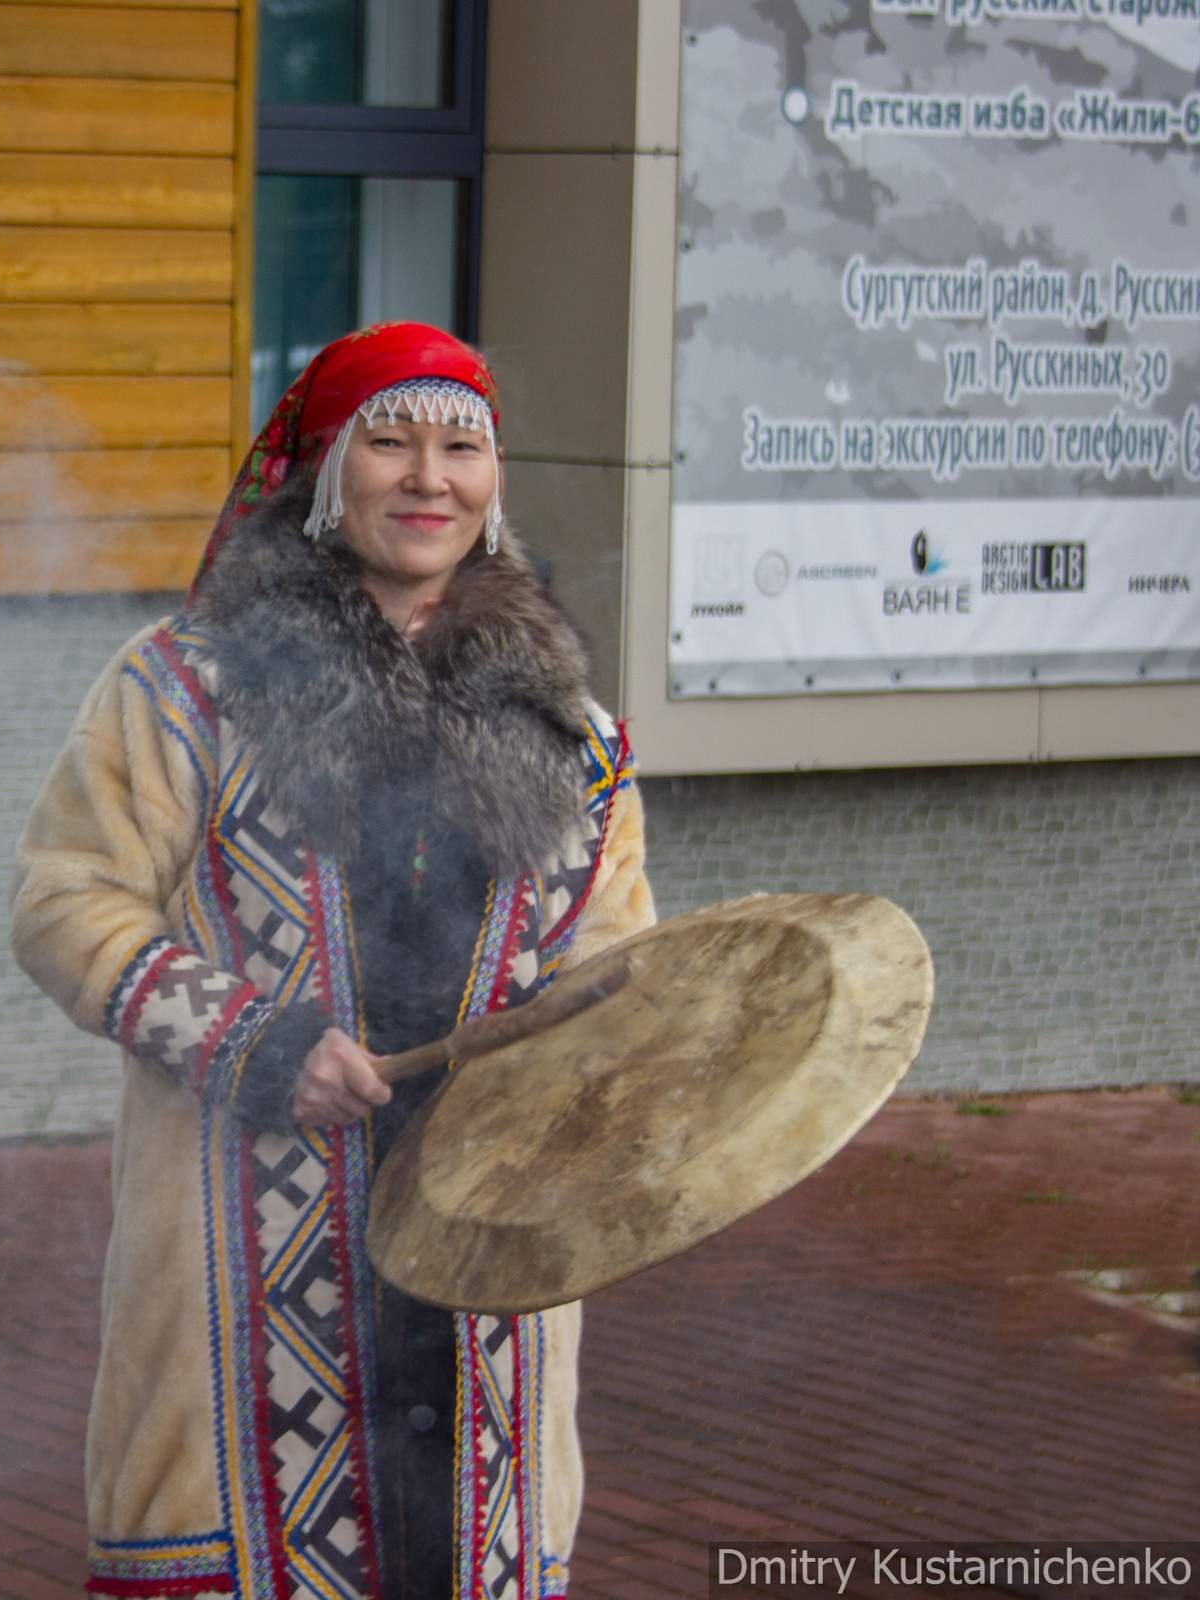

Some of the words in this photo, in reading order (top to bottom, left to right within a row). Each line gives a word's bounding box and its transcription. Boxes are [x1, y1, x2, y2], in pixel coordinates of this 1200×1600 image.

[832, 87, 962, 132] Детская
[974, 91, 1046, 131] изба
[847, 262, 982, 325] Сургутский
[993, 265, 1072, 322] район,
[1079, 274, 1103, 317] д.
[949, 352, 983, 396] ул.
[995, 340, 1129, 396] Русскиных,
[1139, 352, 1168, 400] 30
[747, 415, 834, 463] Запись
[845, 425, 873, 462] на
[879, 425, 1006, 475] экскурсии
[1016, 424, 1045, 461] по
[1054, 410, 1174, 472] телефону:
[982, 542, 1029, 567] ARCTIC
[1034, 545, 1083, 590] LAB
[981, 570, 1029, 594] DESIGN
